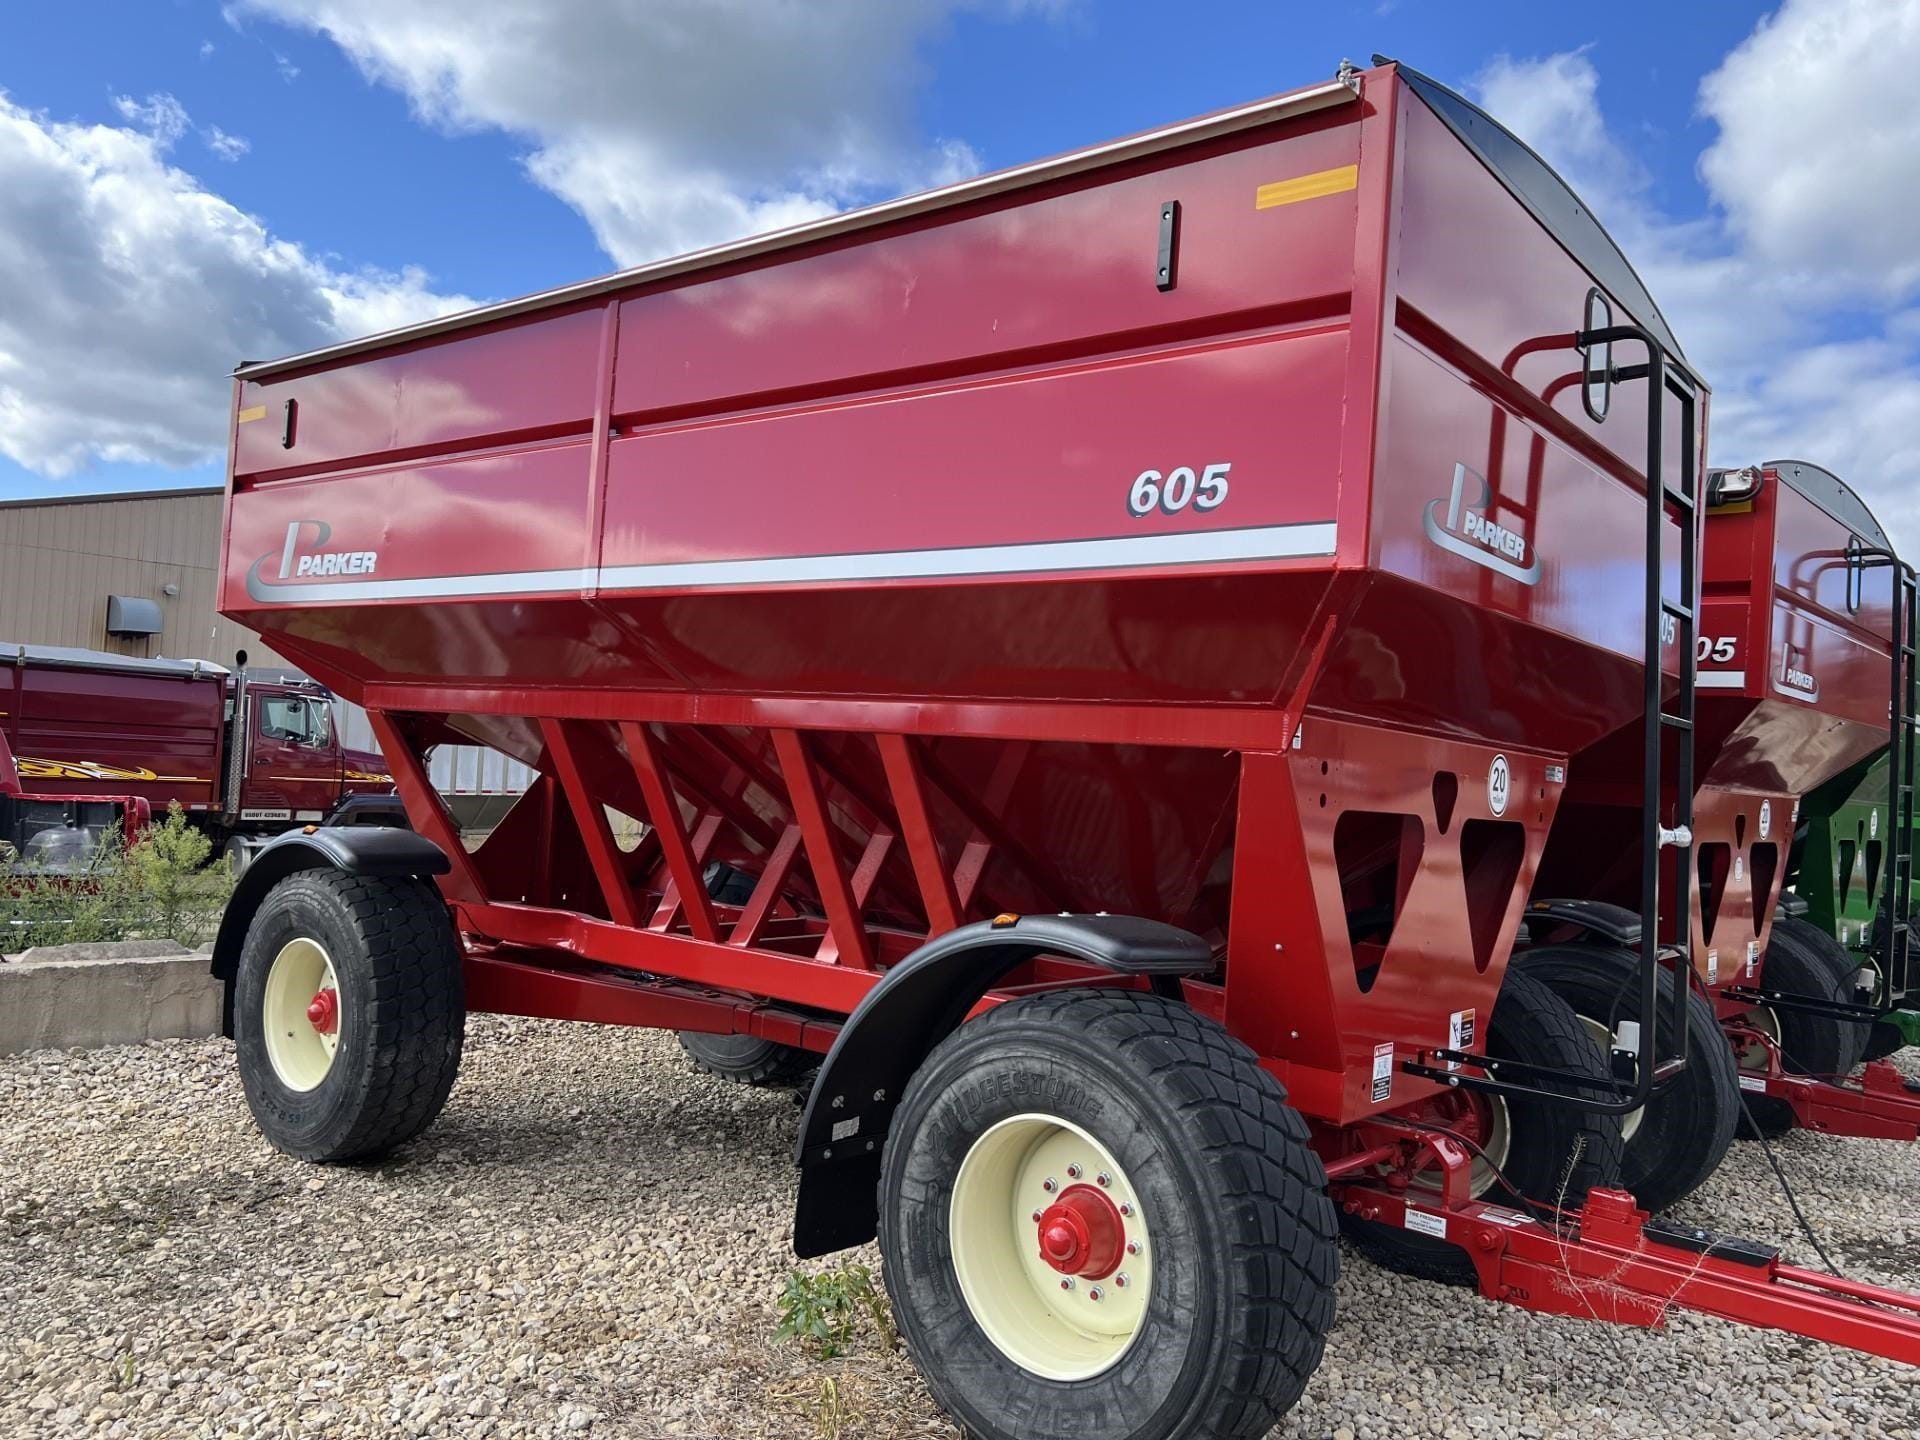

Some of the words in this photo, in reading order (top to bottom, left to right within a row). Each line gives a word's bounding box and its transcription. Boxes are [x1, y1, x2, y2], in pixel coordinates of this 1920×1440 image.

[1128, 462, 1231, 516] 605
[1463, 511, 1526, 561] PARKER
[296, 551, 377, 577] PARKER
[1661, 613, 1675, 645] 05
[1696, 636, 1737, 662] 05
[1787, 668, 1814, 690] PARKER
[1492, 767, 1506, 793] 20
